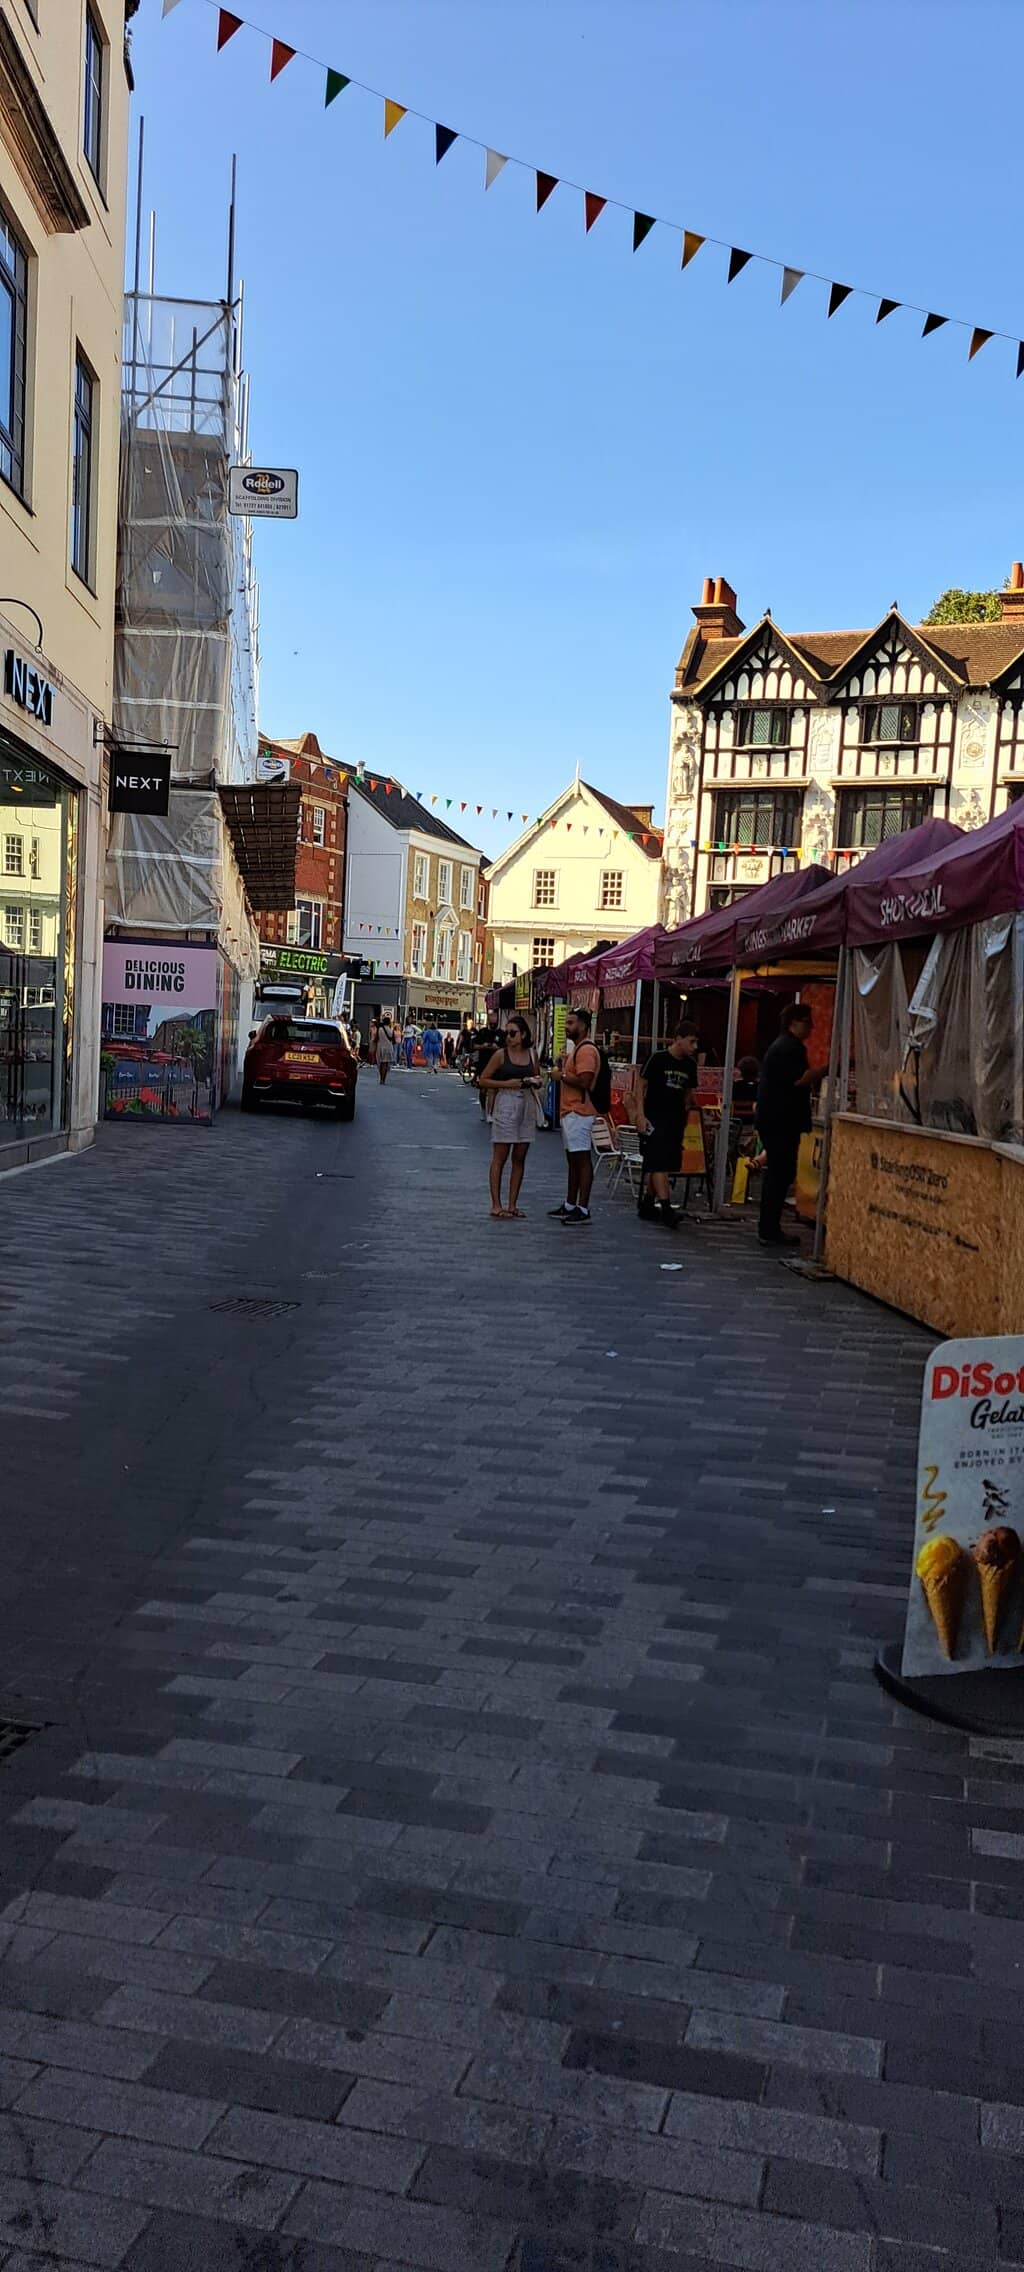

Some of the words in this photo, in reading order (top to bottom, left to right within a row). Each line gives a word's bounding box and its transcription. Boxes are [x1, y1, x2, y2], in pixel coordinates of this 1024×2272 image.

[246, 478, 281, 488] Rodell
[5, 650, 56, 726] NEXT
[115, 775, 163, 791] NEXT
[126, 959, 185, 974] DELICIOUS
[279, 951, 328, 973] ELECTRIC
[960, 1450, 989, 1459] BORN
[994, 1447, 1005, 1455] IN
[954, 1458, 1004, 1468] ENJOYED
